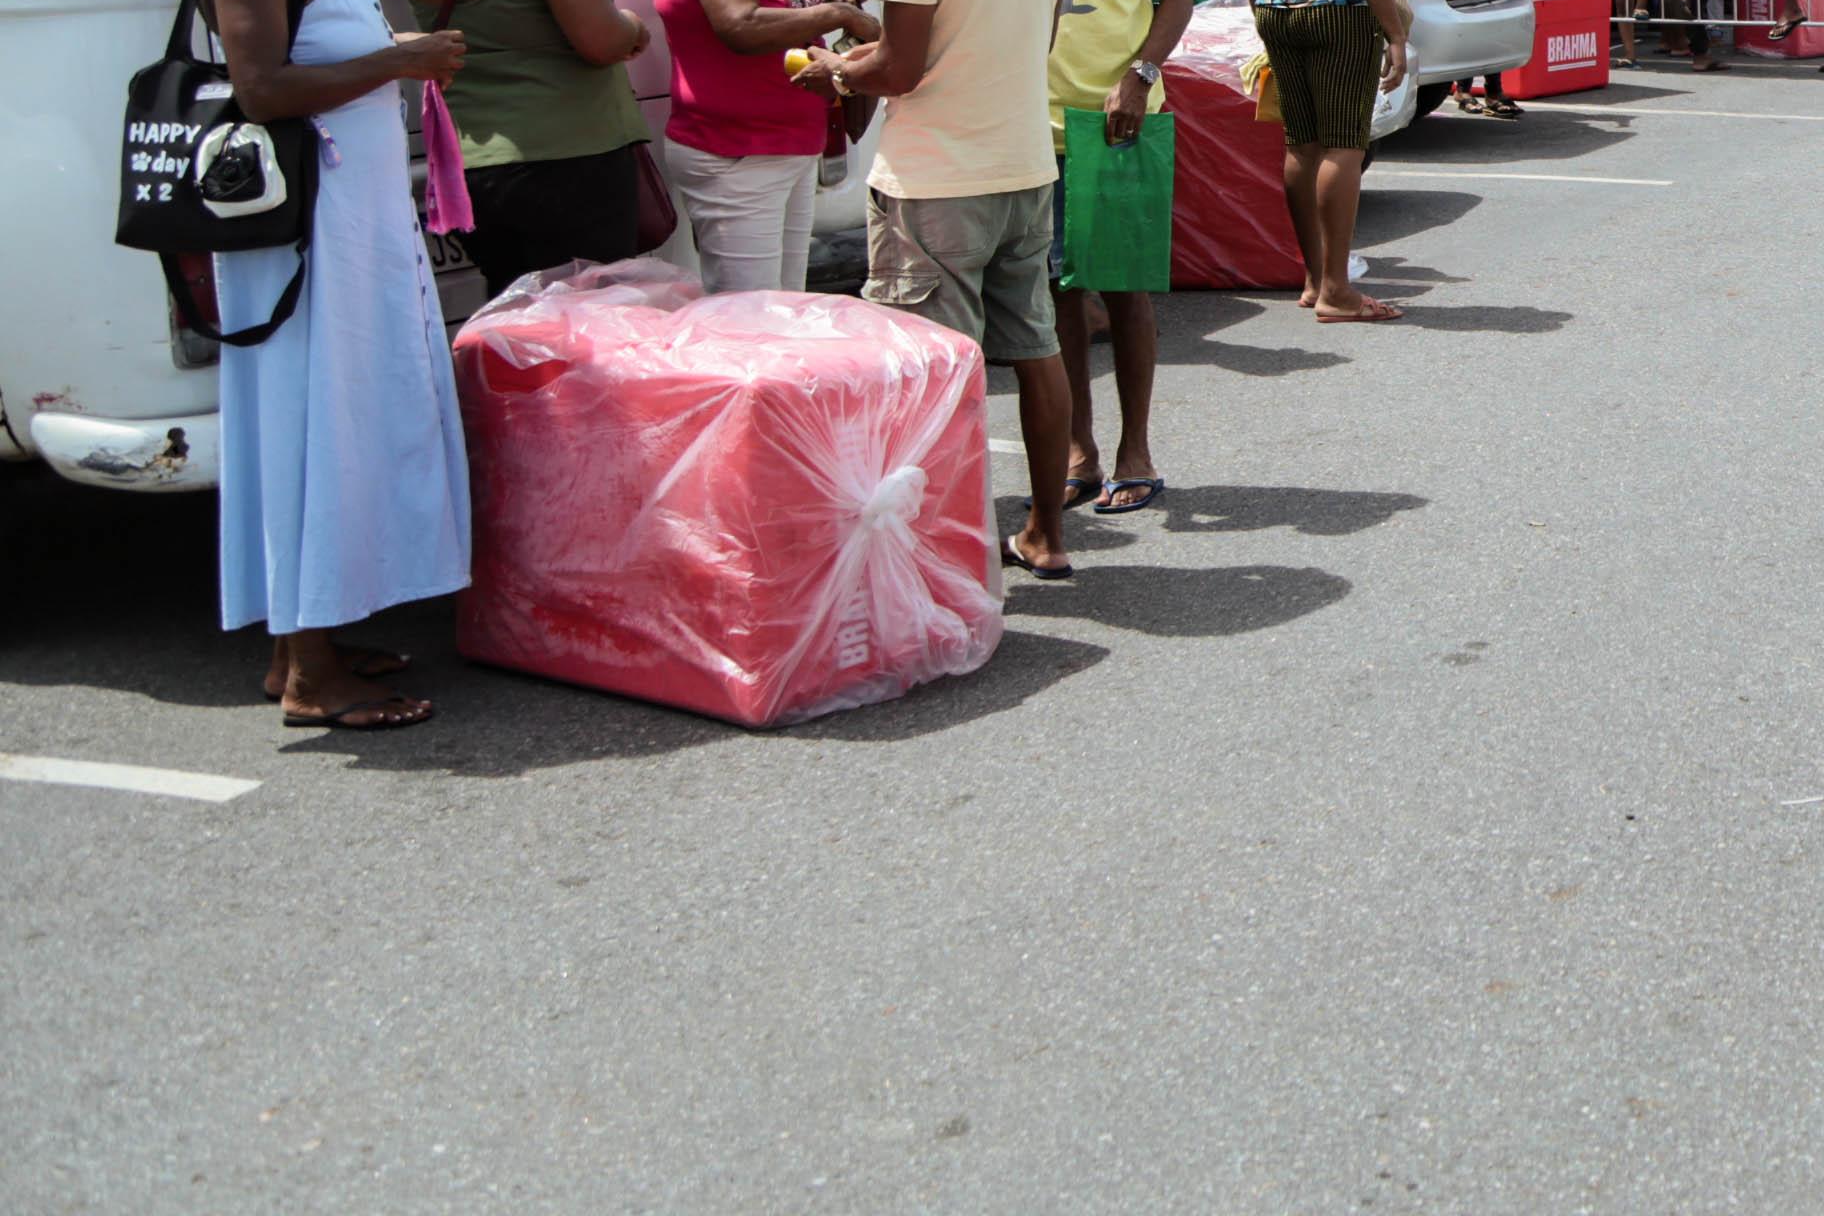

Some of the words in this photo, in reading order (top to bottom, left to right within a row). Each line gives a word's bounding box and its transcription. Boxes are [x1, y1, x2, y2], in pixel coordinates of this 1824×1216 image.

[1547, 32, 1597, 63] BRAHMA
[129, 121, 202, 145] HAPPY
[151, 150, 190, 179] day
[158, 182, 173, 201] 2
